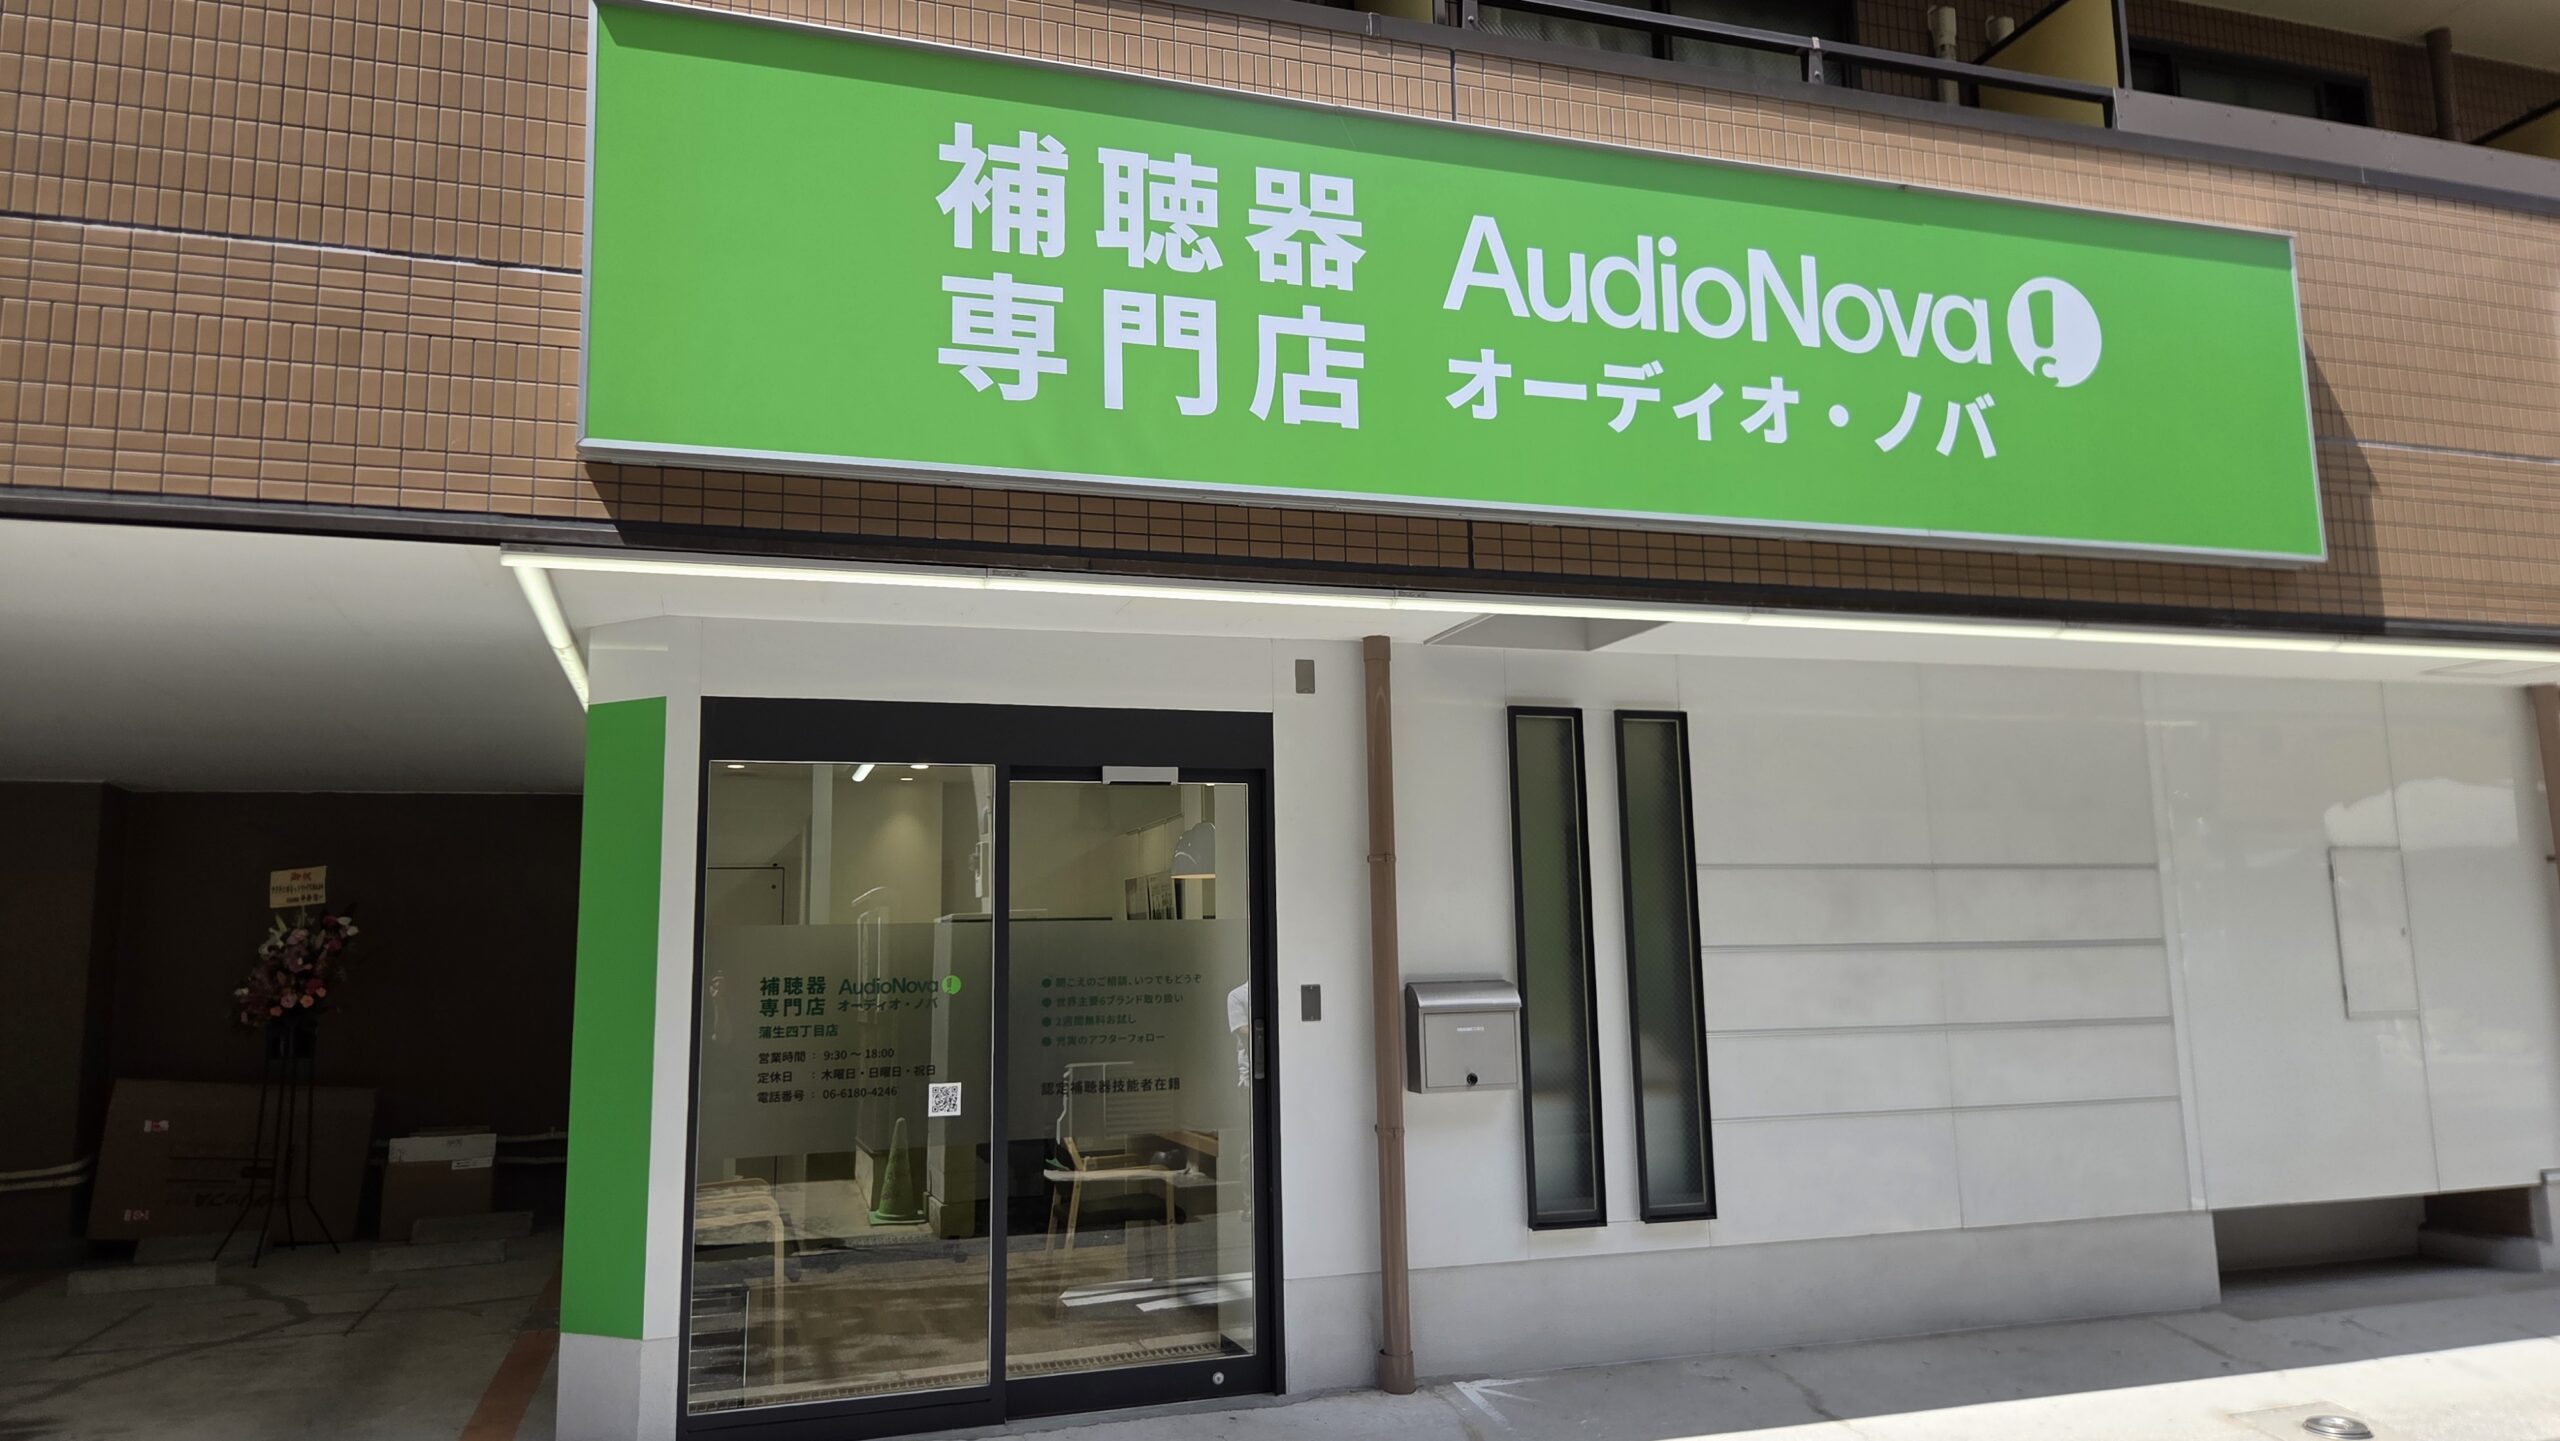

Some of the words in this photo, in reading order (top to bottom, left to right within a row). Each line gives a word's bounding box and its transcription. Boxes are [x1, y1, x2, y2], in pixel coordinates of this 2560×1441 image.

[936, 124, 1366, 291] 補聴器
[1444, 216, 1992, 365] AudioNova
[936, 273, 1366, 429] 専門店
[1445, 348, 1999, 459] オーディオ・ノバ
[760, 976, 827, 995] 補聴器
[838, 978, 938, 995] AudioNova
[760, 997, 826, 1017] 専門店
[838, 998, 938, 1012] オーディオ・ノバ
[758, 1024, 838, 1039] 蒲生四丁目店
[823, 1087, 898, 1099] 06-6180-4246
